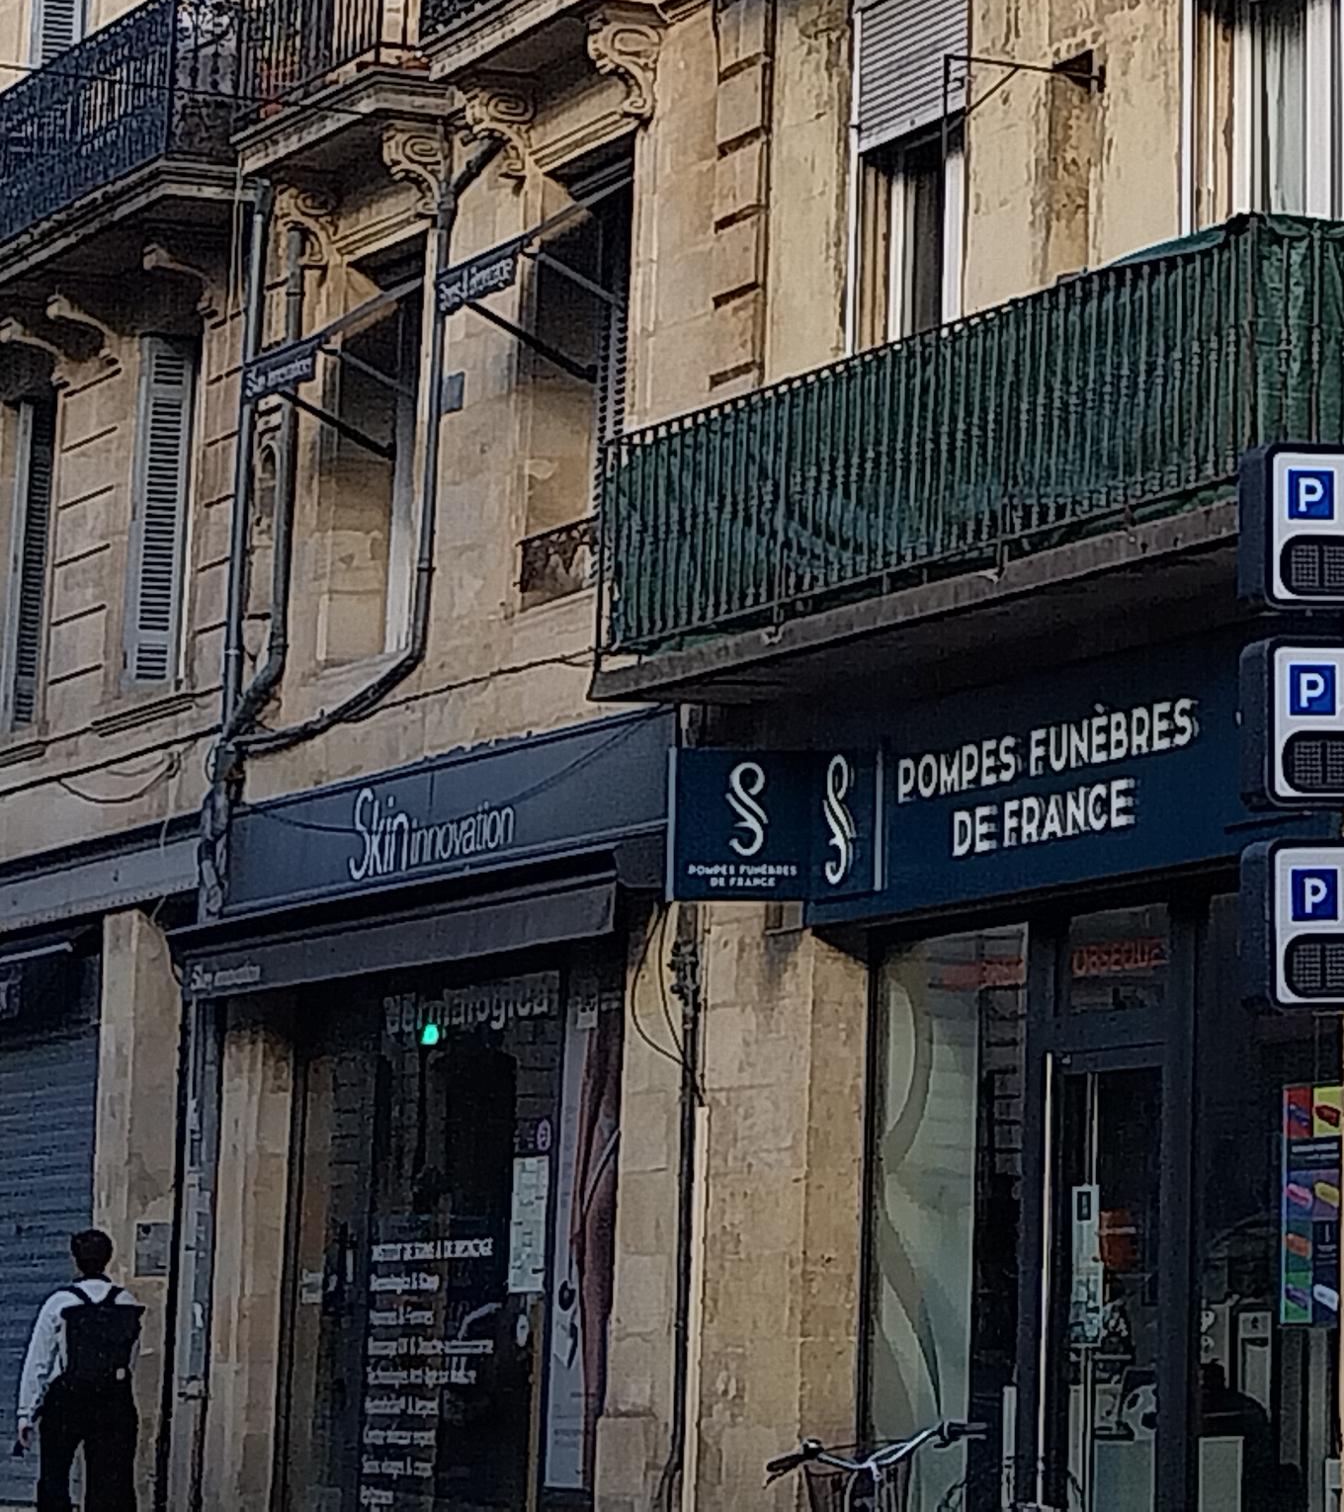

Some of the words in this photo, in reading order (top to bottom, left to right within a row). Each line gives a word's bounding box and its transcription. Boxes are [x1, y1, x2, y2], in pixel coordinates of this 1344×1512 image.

[1298, 477, 1324, 512] P
[1299, 672, 1325, 708] P
[898, 736, 1021, 804] POMPES
[1029, 698, 1199, 778] FUNÈBRES
[350, 787, 410, 881] Skin
[410, 800, 515, 866] innovation
[952, 804, 998, 857] DE
[1003, 777, 1137, 848] FRANCE
[688, 864, 735, 876] POMPES
[710, 877, 726, 887] DE
[729, 877, 777, 887] FRANCE
[1303, 877, 1328, 914] P
